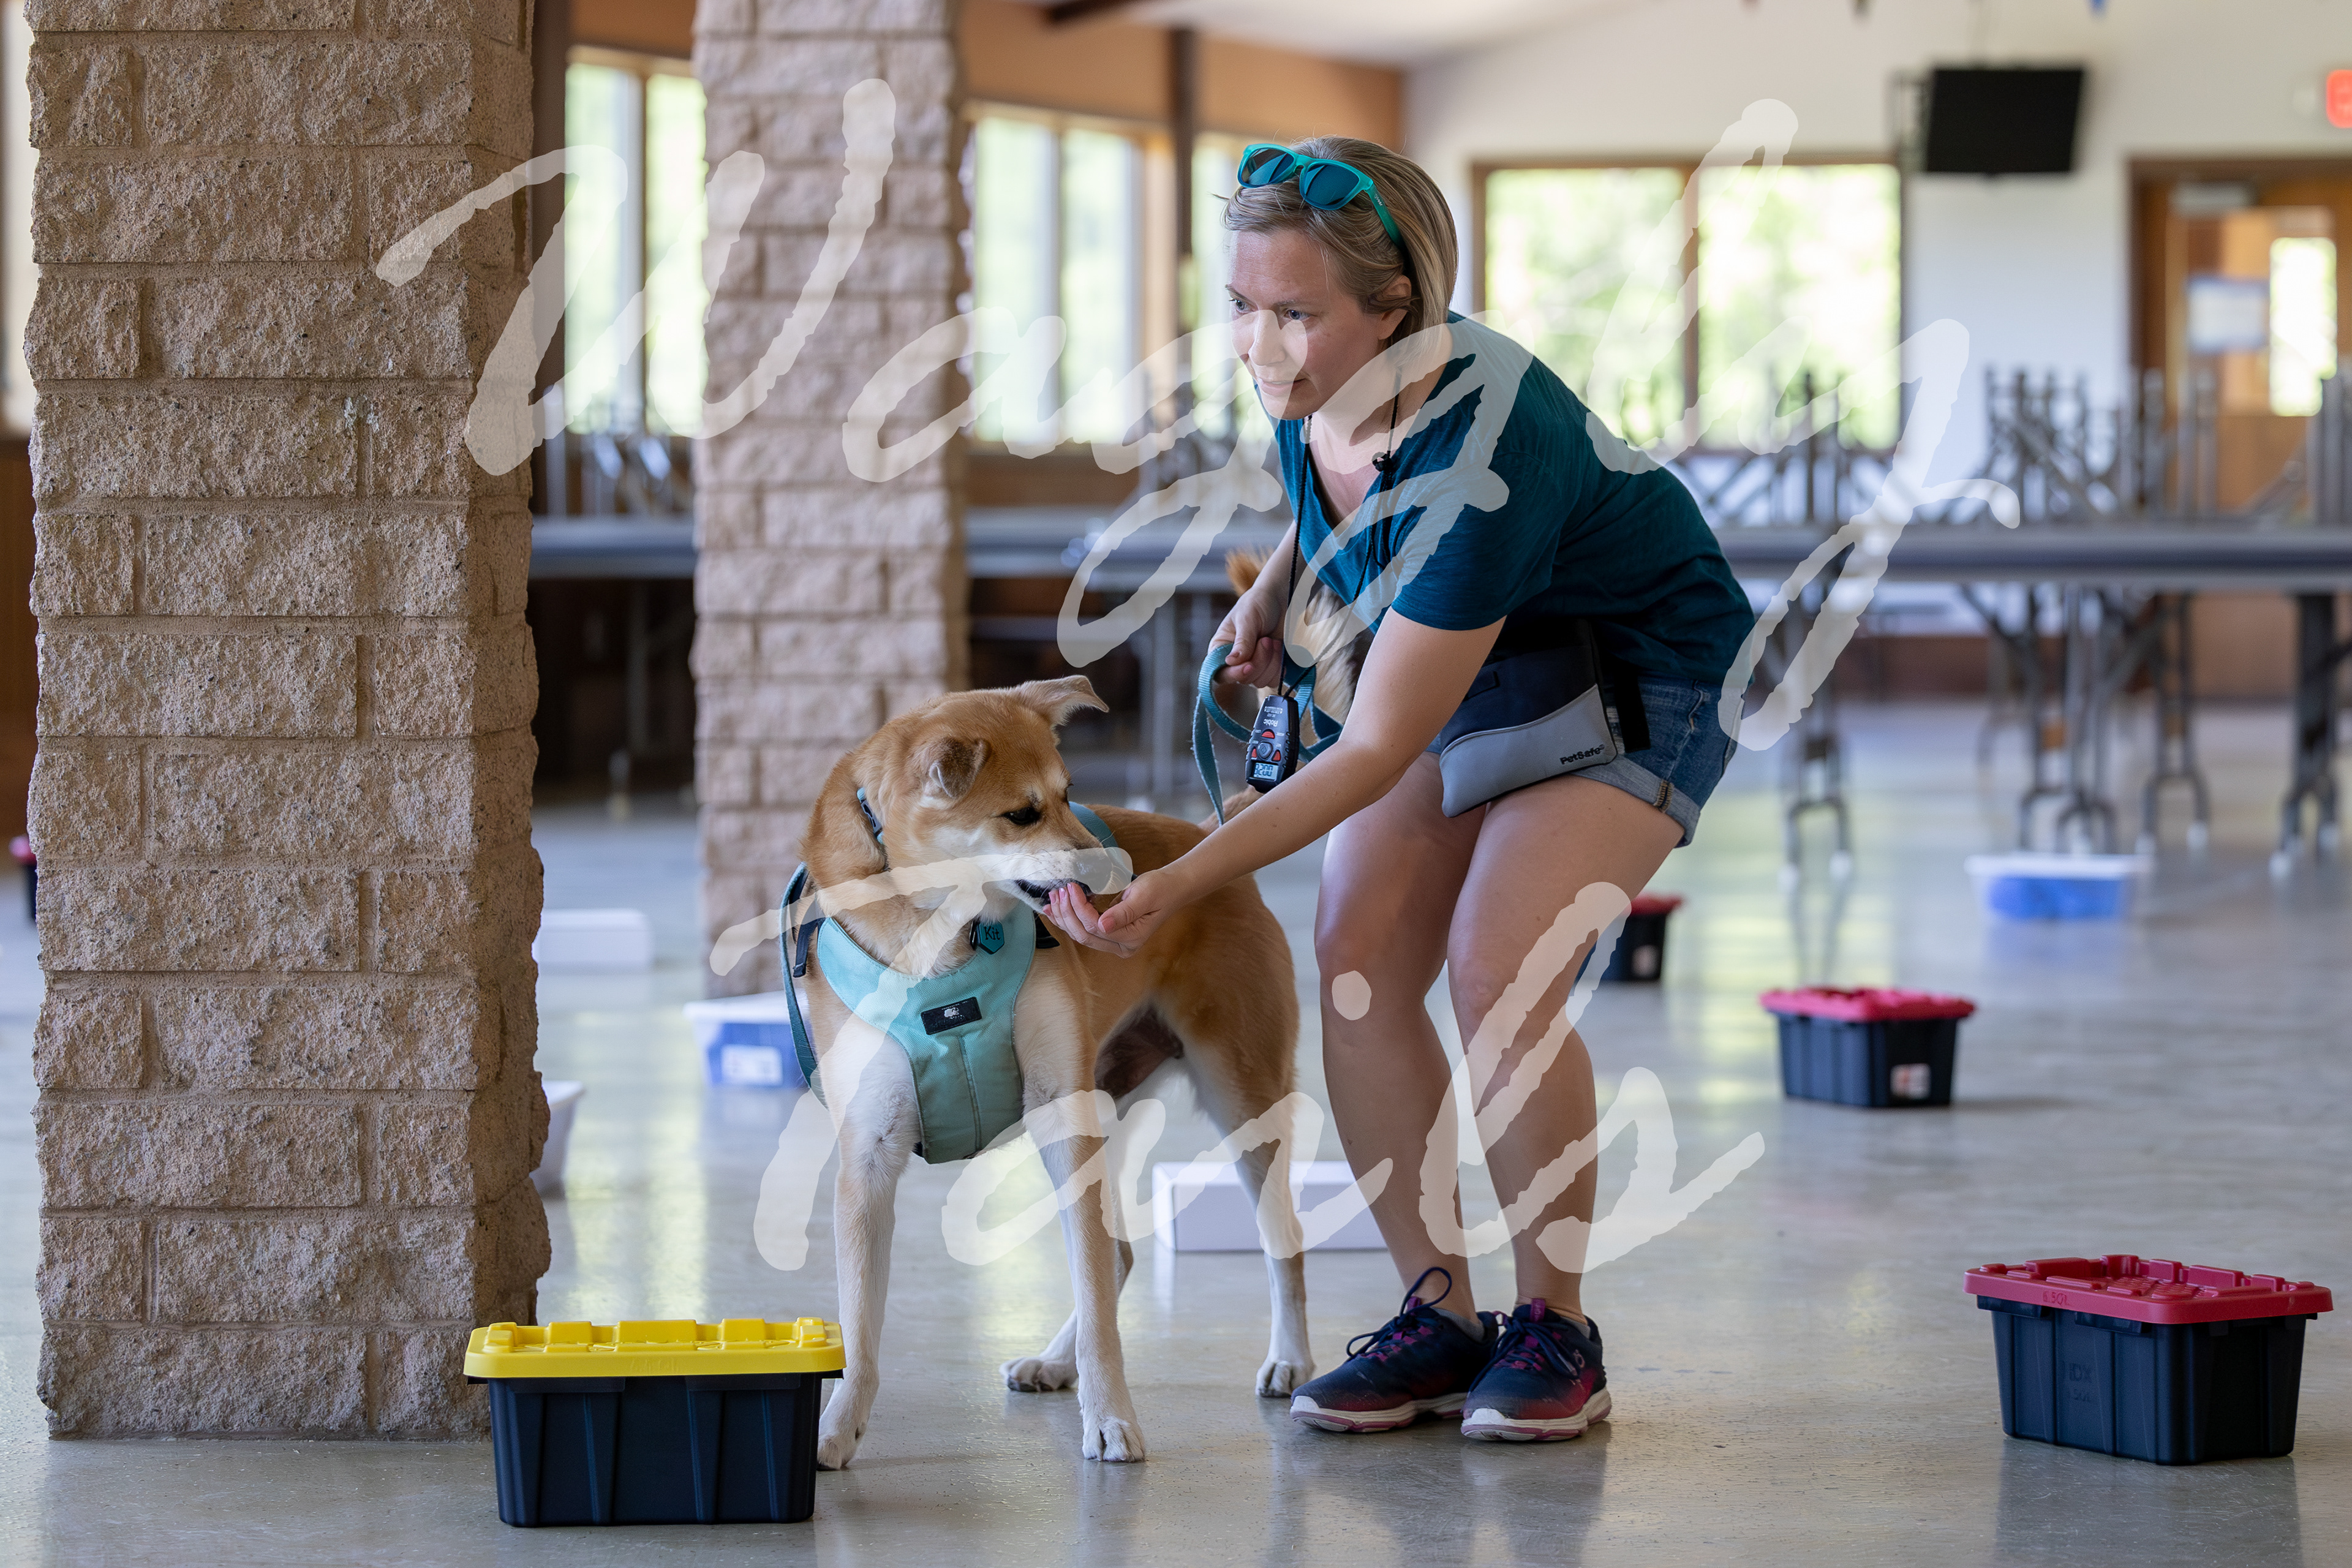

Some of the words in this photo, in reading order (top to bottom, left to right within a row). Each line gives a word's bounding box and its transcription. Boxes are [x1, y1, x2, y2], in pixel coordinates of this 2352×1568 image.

[1263, 718, 1278, 727] Robic
[1559, 746, 1602, 765] PetSafe
[984, 925, 1001, 940] Kit
